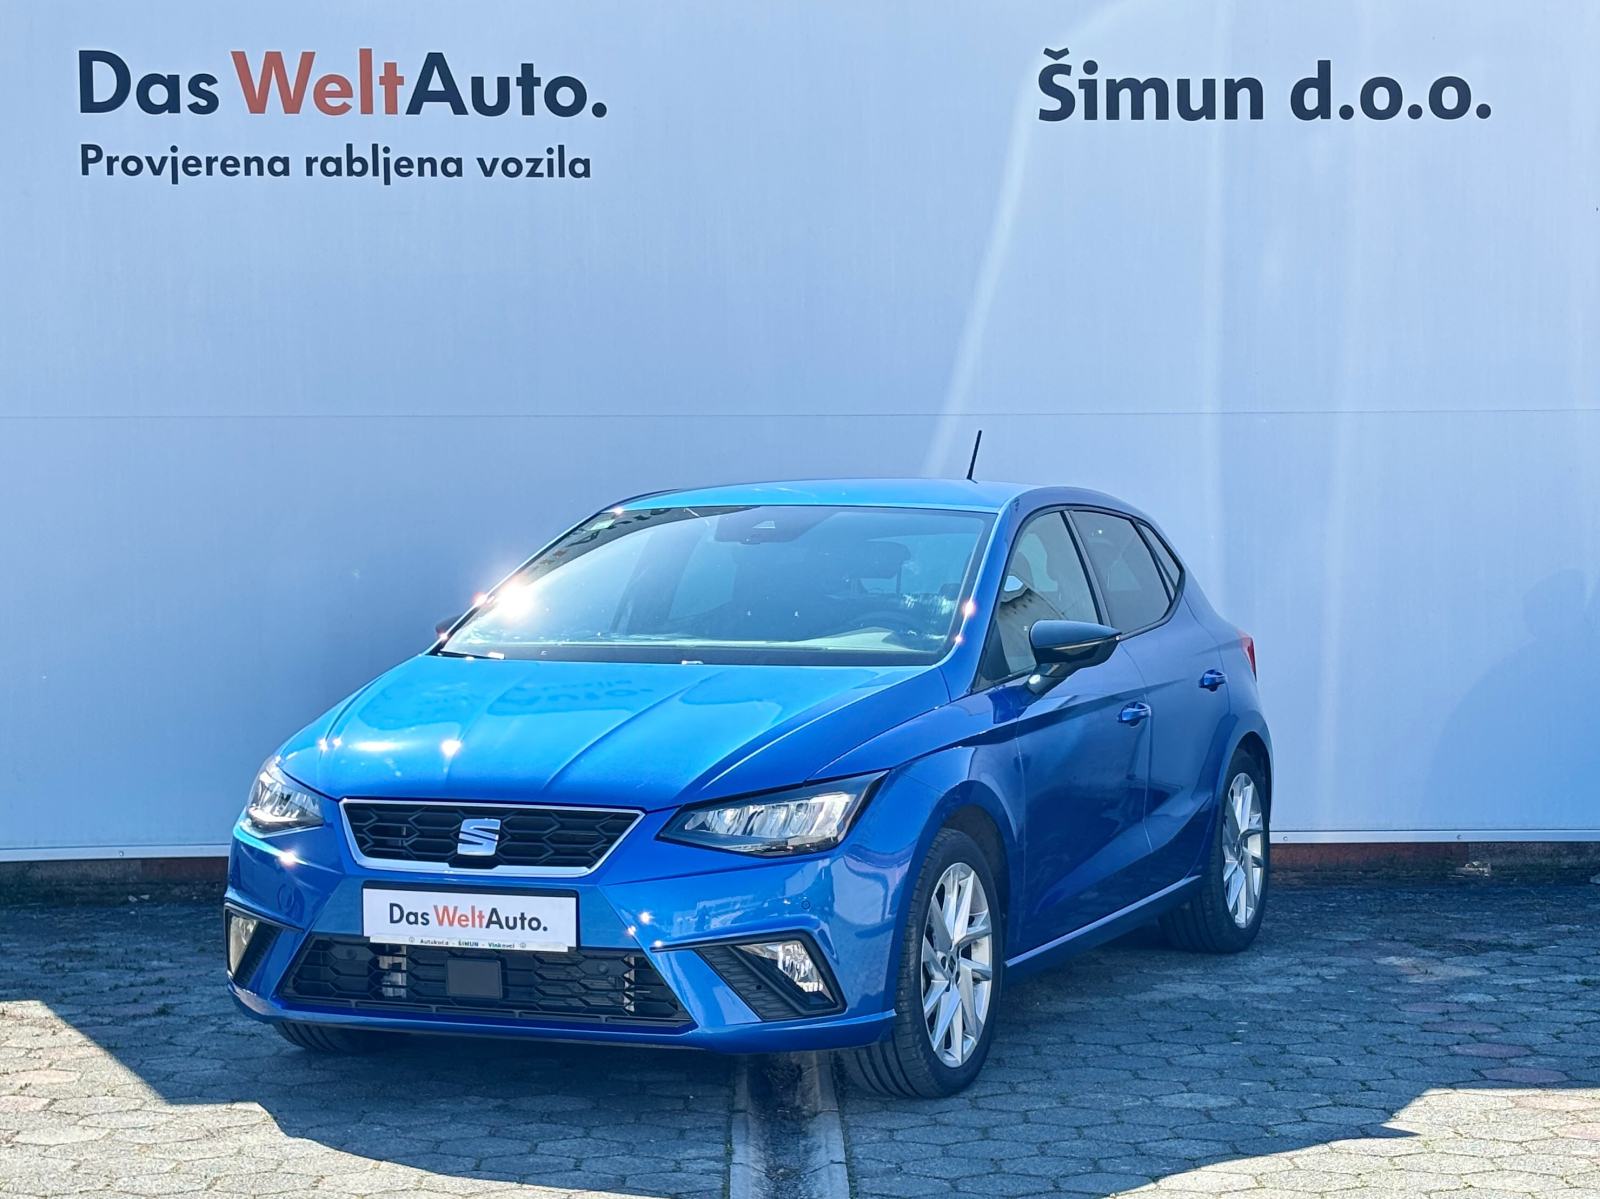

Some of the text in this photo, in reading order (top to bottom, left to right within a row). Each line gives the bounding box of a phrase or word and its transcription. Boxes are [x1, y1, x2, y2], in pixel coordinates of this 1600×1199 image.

[79, 48, 607, 118] Das WeltAuto.
[1038, 48, 1491, 121] Šimun d.o.o.
[81, 143, 590, 185] Provjerena rabljena vozila
[389, 902, 548, 932] Das WeltAuto.
